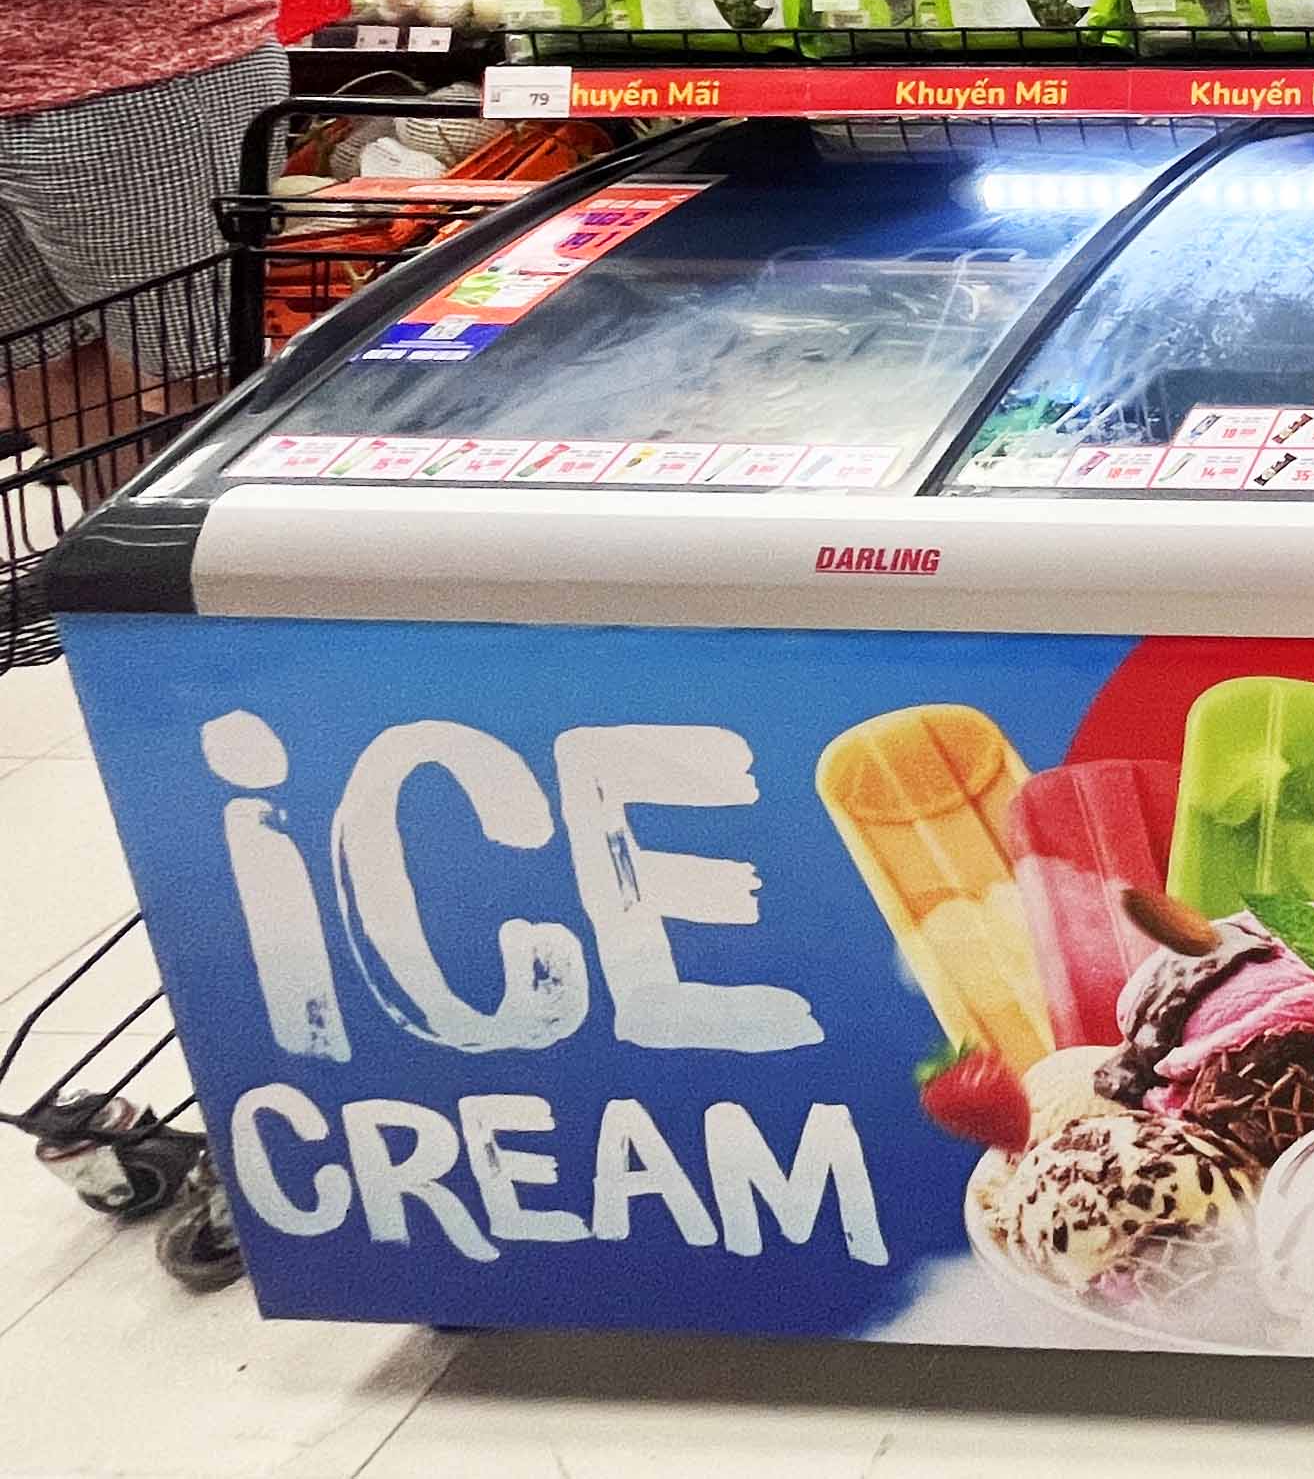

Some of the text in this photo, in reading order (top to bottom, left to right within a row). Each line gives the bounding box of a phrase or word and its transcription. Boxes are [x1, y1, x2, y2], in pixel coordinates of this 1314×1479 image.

[529, 93, 549, 105] 79
[572, 79, 720, 110] huyến Mãi
[897, 78, 1068, 110] Khuyến Mãi
[1191, 79, 1302, 110] Khuyến
[816, 546, 941, 572] DARLING
[231, 1082, 890, 1267] CREAM
